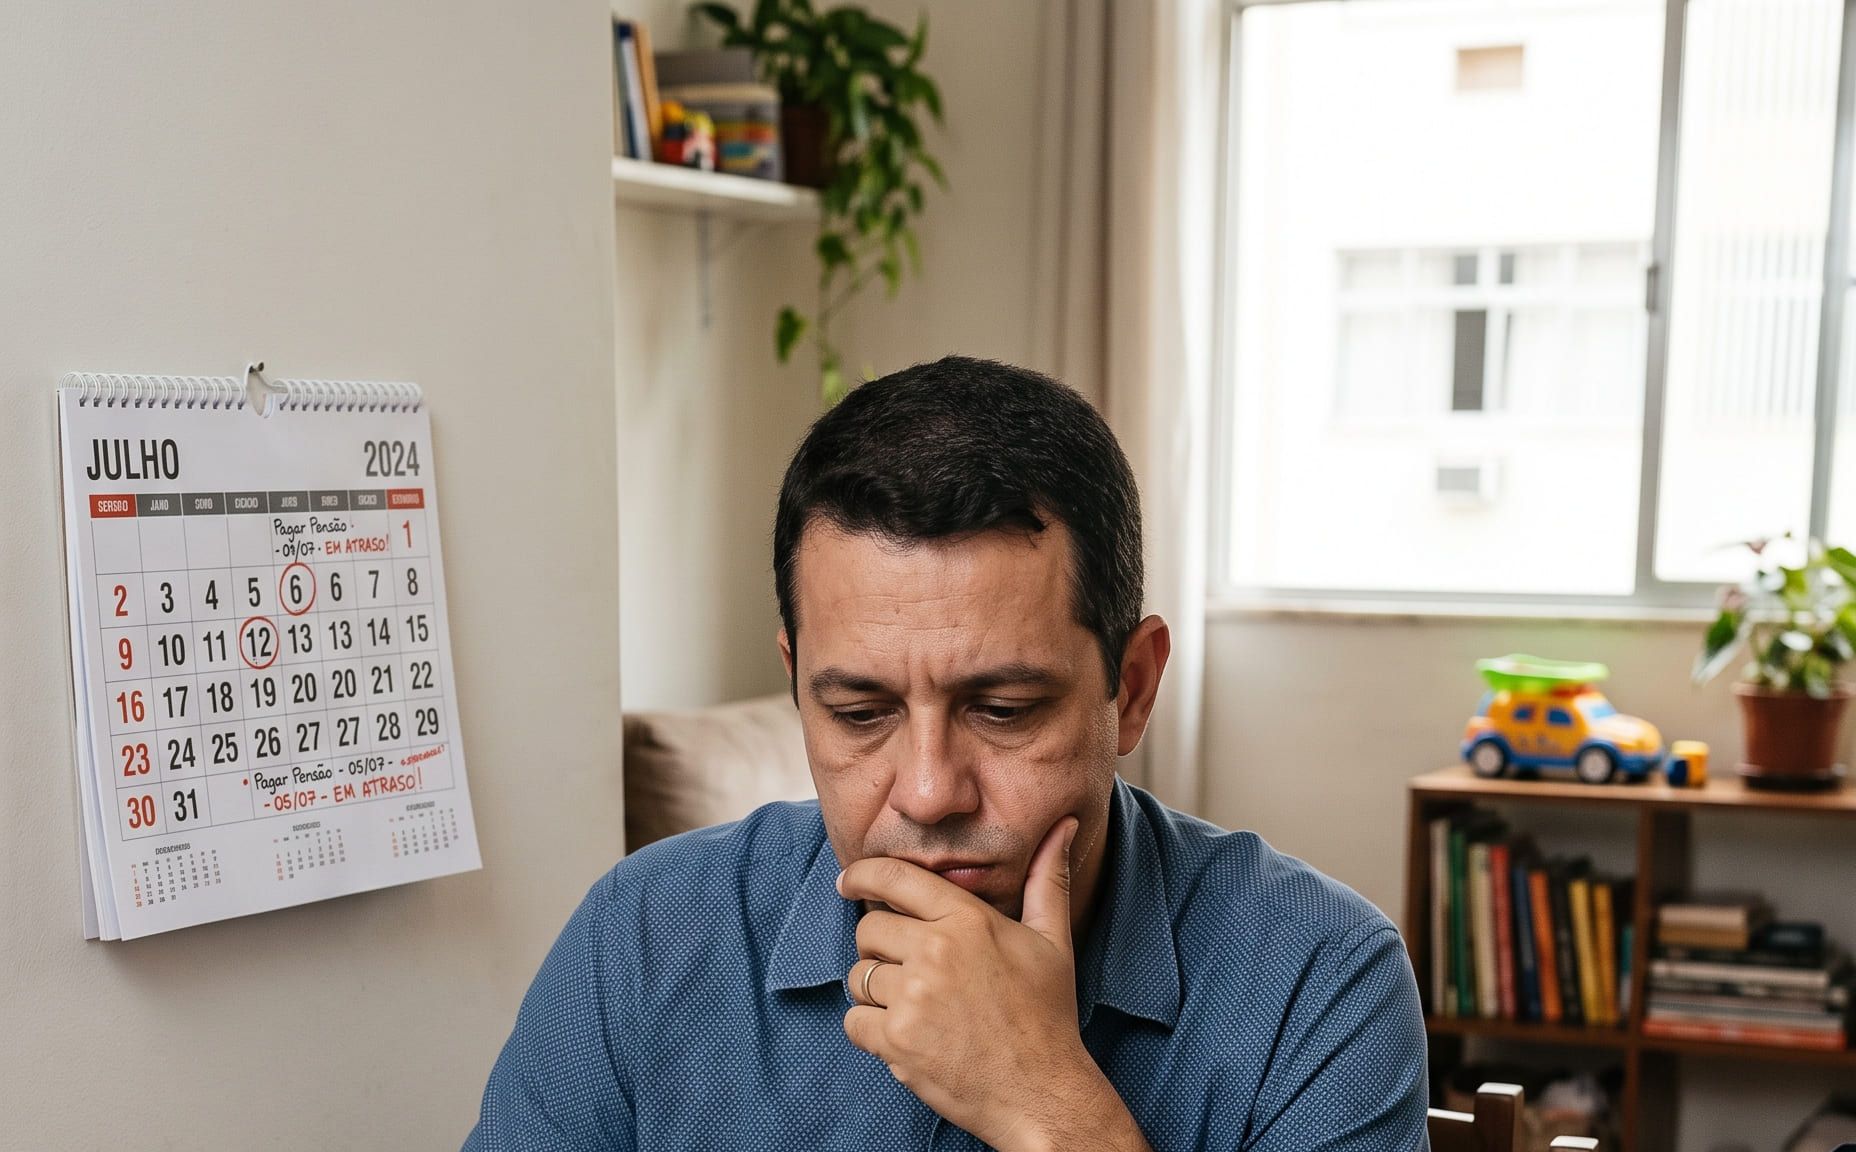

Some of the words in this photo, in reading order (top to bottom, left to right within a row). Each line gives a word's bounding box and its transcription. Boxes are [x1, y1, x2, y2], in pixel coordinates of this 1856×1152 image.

[87, 439, 179, 480] JULHO
[364, 441, 419, 477] 2024
[274, 518, 306, 544] Pagar
[309, 516, 347, 535] Pensão
[325, 540, 341, 554] EM
[345, 533, 389, 553] ATRASO!
[402, 520, 413, 549] 1
[206, 580, 218, 610] 4
[248, 578, 260, 607] 5
[290, 575, 301, 604] 6
[331, 573, 342, 601] 6
[369, 570, 379, 598] 7
[407, 568, 418, 595] 8
[114, 585, 128, 616] 2
[160, 583, 174, 613] 3
[245, 625, 271, 657] 12
[288, 624, 312, 654] 13
[329, 621, 352, 650] 13
[367, 618, 390, 646] 14
[406, 615, 428, 642] 15
[119, 638, 132, 670] 9
[158, 634, 185, 666] 10
[203, 630, 226, 662] 11
[292, 673, 316, 703] 20
[332, 669, 356, 698] 20
[372, 665, 392, 694] 21
[411, 661, 433, 689] 22
[117, 691, 144, 723] 16
[163, 686, 188, 718] 17
[207, 682, 233, 713] 18
[251, 677, 276, 708] 19
[297, 722, 320, 752] 27
[337, 717, 359, 746] 27
[377, 712, 400, 741] 28
[416, 708, 438, 736] 29
[168, 738, 195, 770] 24
[212, 732, 238, 764] 25
[255, 727, 281, 758] 26
[122, 743, 150, 776] 23
[254, 772, 288, 795] Pagar
[292, 763, 333, 784] Pensão
[348, 756, 384, 776] 05/07
[274, 790, 316, 811] 05/07
[333, 785, 355, 803] EM
[363, 767, 422, 798] ATRASO!
[128, 795, 155, 828] 30
[174, 789, 198, 821] 31
